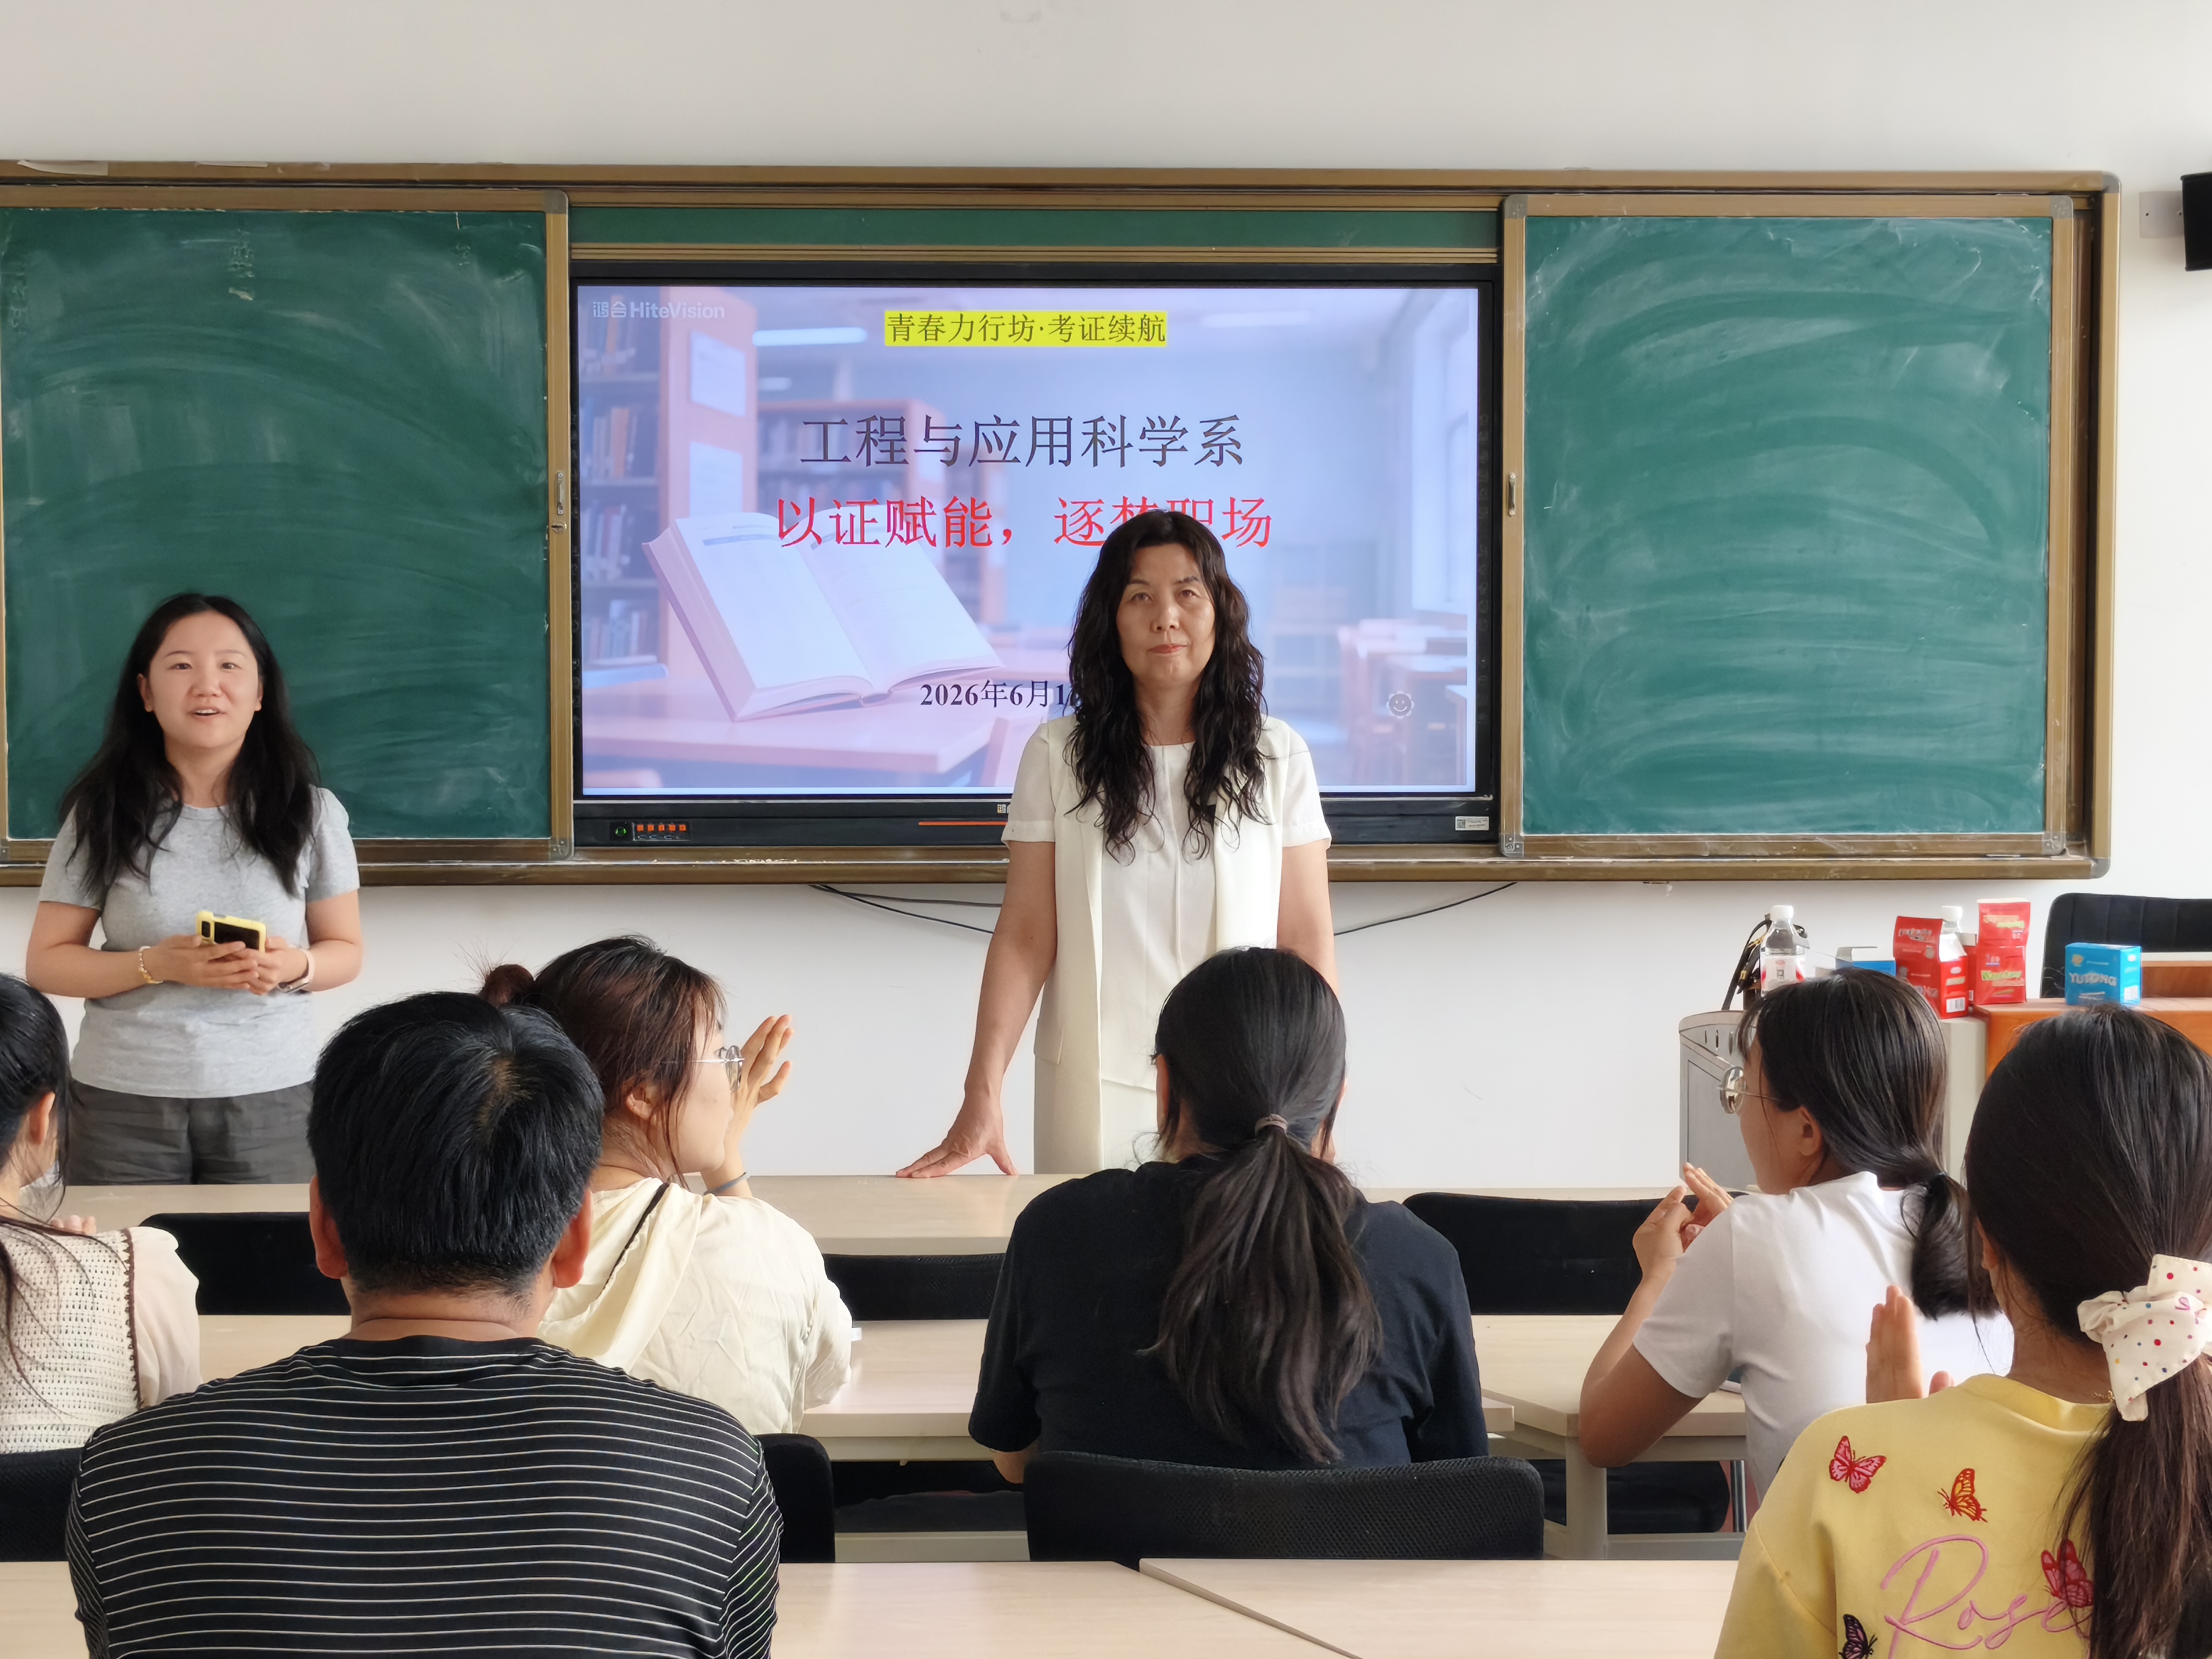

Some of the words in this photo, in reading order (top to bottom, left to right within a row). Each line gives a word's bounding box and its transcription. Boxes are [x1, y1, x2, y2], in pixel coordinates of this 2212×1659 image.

[887, 313, 1165, 343] 青春力行坊·考证续航
[800, 414, 1244, 468] 工程与应用科学系
